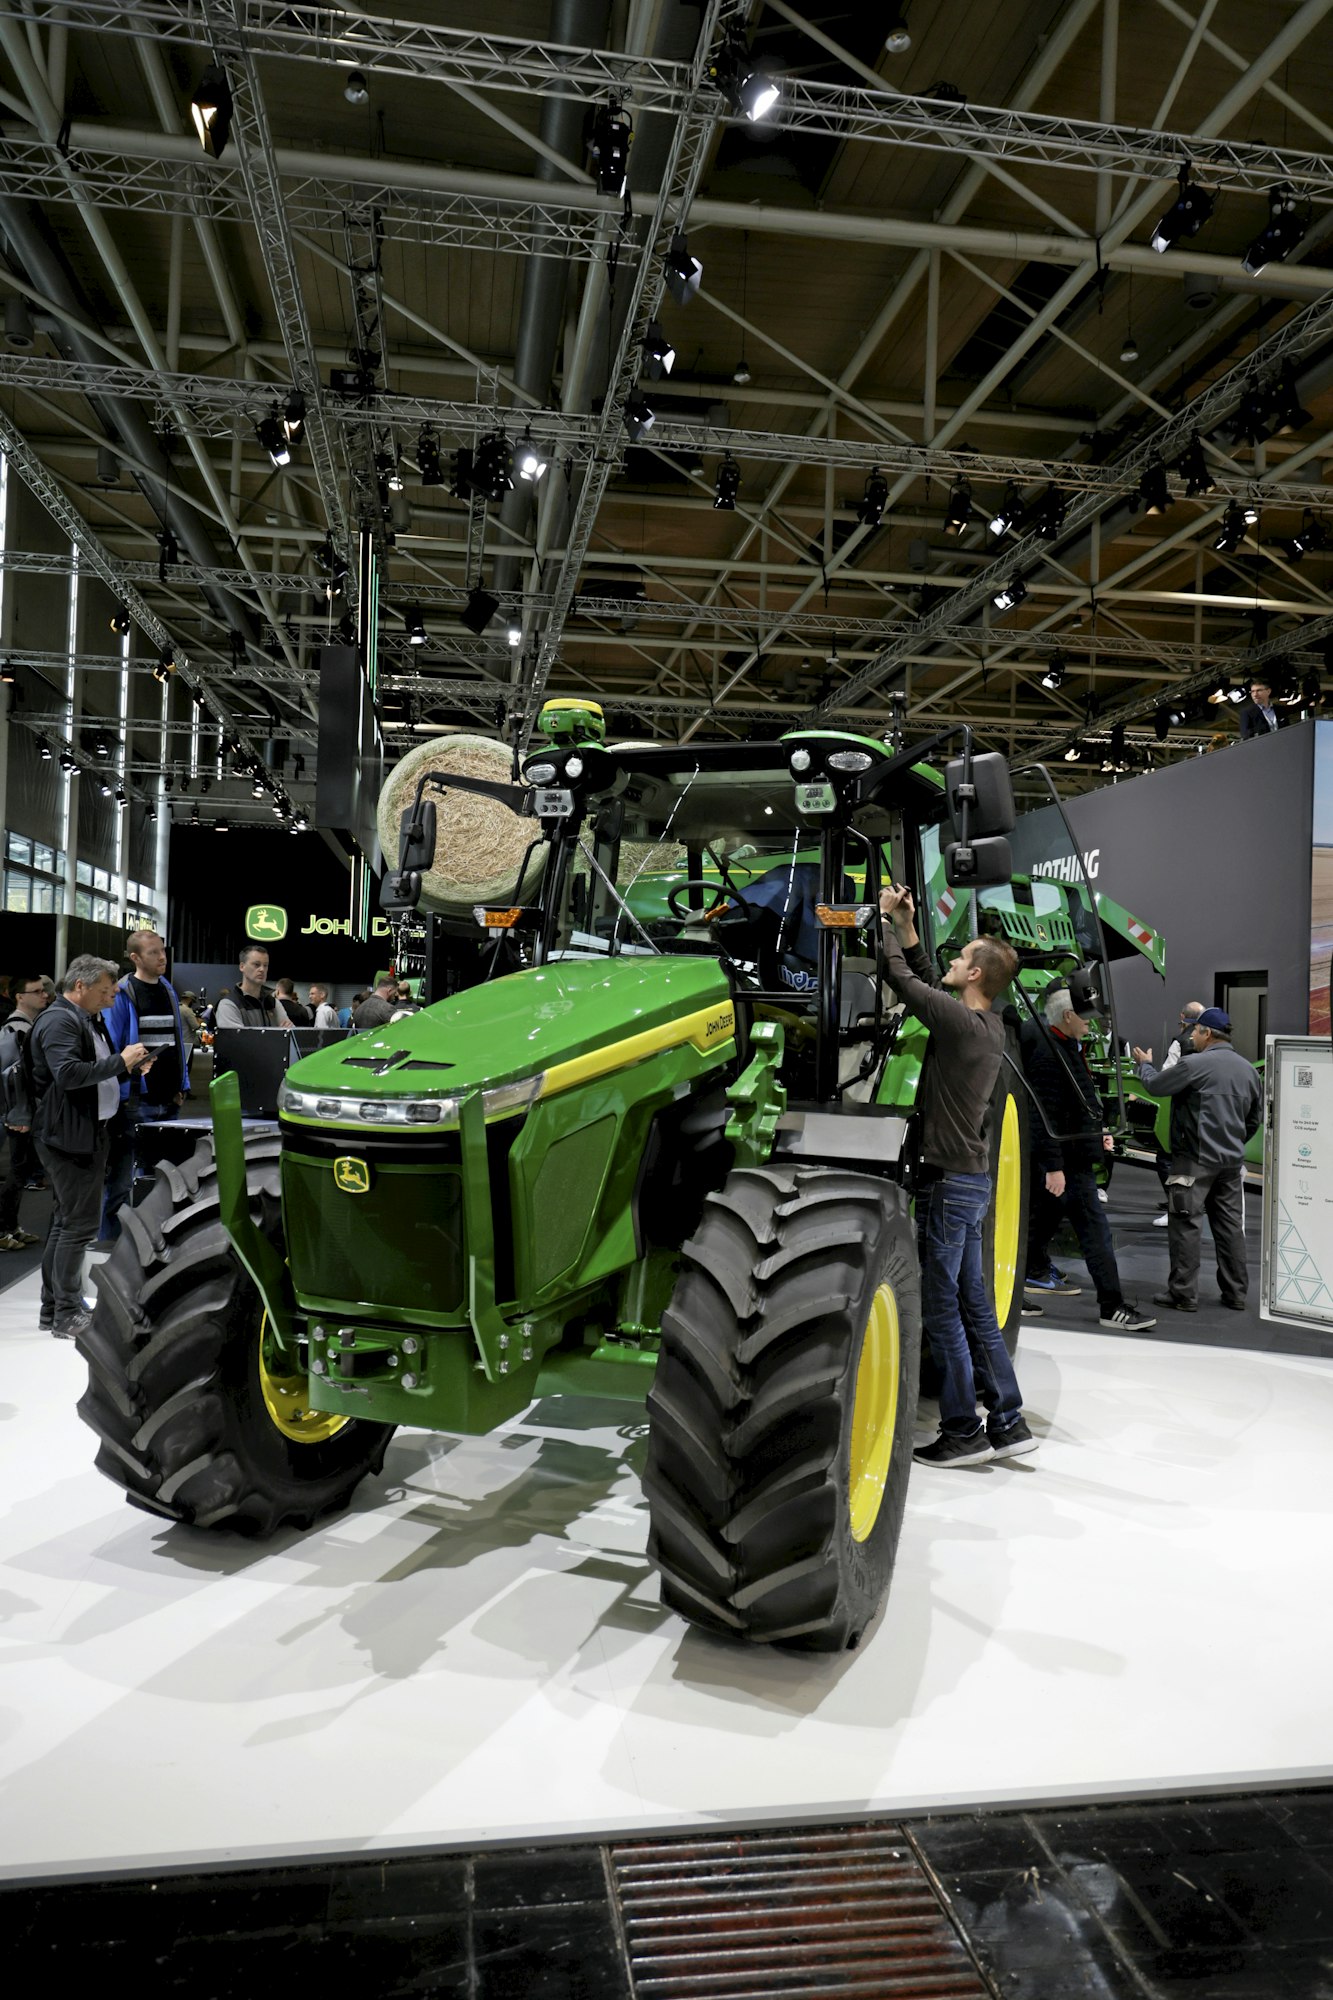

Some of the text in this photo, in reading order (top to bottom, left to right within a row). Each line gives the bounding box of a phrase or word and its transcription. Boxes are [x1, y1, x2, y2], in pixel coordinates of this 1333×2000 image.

[1032, 849, 1100, 882] NOTHING
[301, 914, 350, 935] JOH
[706, 1013, 733, 1037] JOHN DEERE
